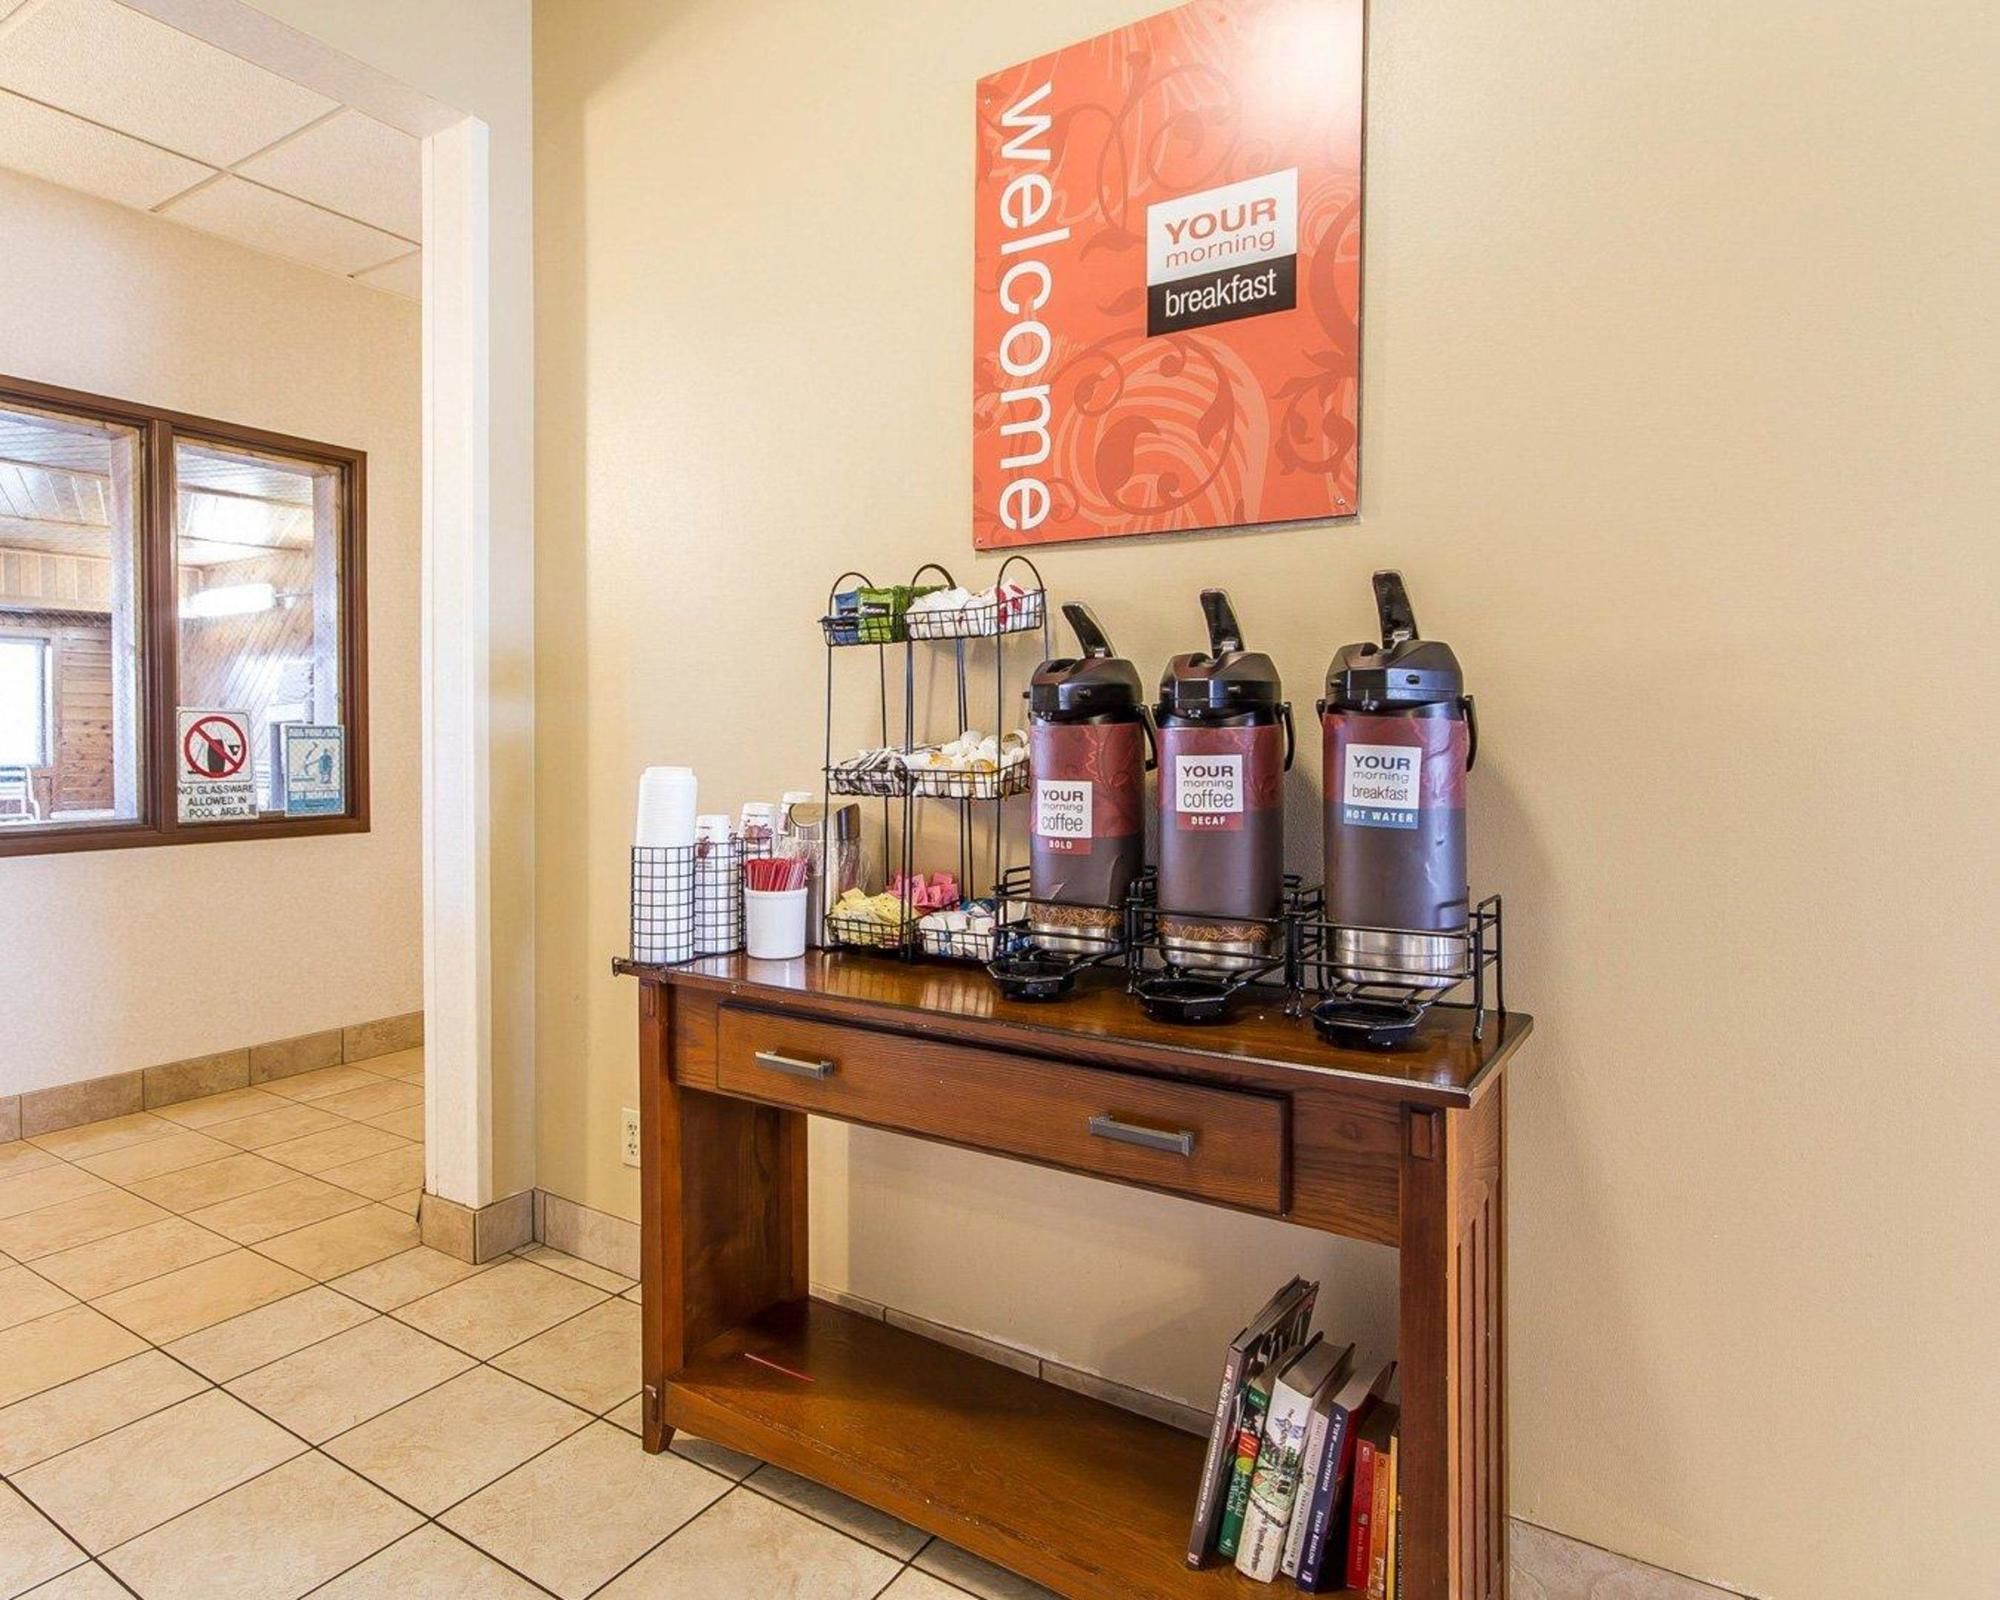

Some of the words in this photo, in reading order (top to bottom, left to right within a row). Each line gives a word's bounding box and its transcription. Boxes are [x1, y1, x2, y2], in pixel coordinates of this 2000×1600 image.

[1164, 197, 1277, 245] YOUR
[1165, 229, 1276, 269] morning
[1165, 267, 1277, 318] breakfast
[999, 81, 1070, 530] welcome
[1353, 755, 1411, 771] YOUR
[1183, 765, 1234, 778] YOUR
[1353, 771, 1410, 784] morning
[178, 785, 192, 795] NO
[197, 783, 254, 795] GLASSWARE
[1183, 779, 1234, 791] morning
[1041, 790, 1084, 803] YOUR
[1183, 790, 1234, 808] coffee
[1352, 783, 1409, 802] breakfast
[188, 794, 233, 806] ALLOWED
[239, 795, 247, 804] IN
[189, 807, 216, 818] POOL
[1042, 802, 1084, 813] morning
[1041, 813, 1083, 832] coffee
[1191, 815, 1226, 826] DECAF
[1346, 808, 1367, 823] HOT
[1373, 810, 1414, 824] WATER
[1048, 839, 1073, 850] BOLD
